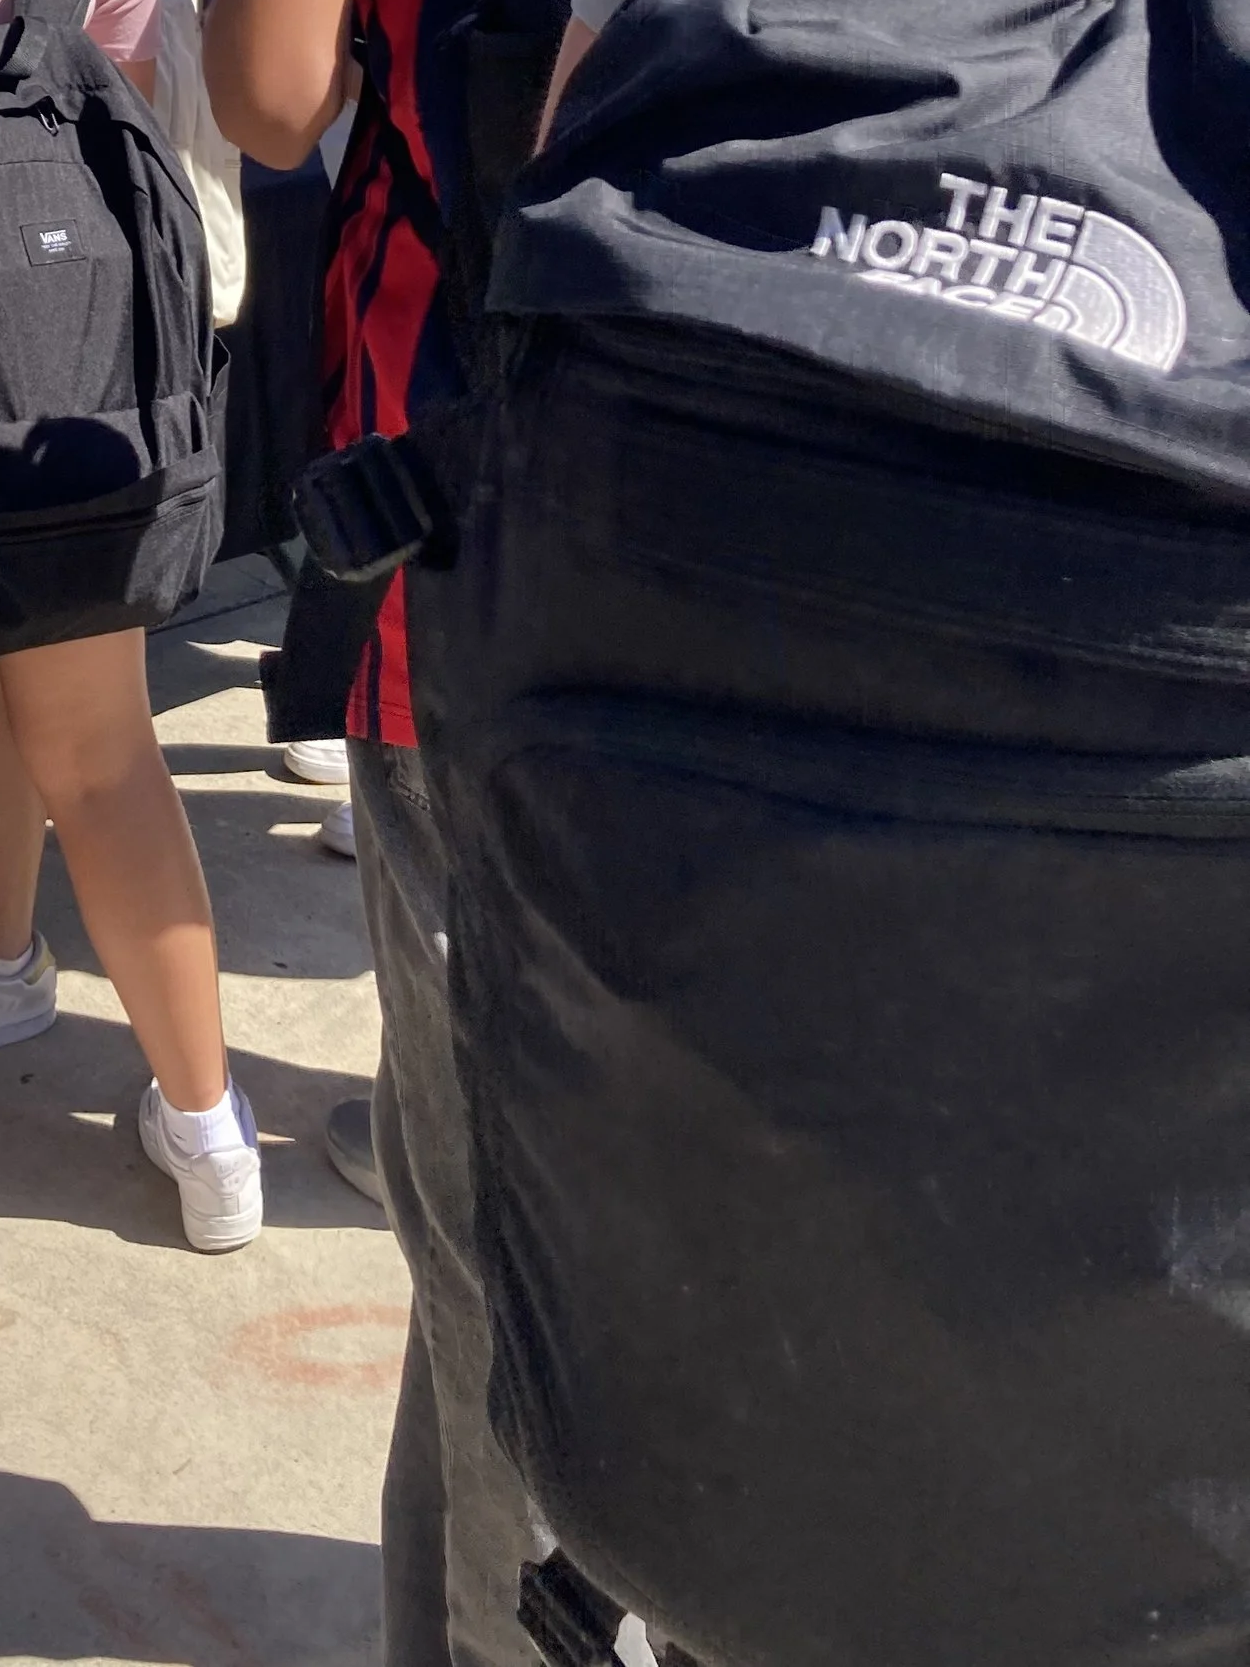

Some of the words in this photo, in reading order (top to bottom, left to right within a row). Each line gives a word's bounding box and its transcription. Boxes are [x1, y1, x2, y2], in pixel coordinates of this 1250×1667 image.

[39, 229, 68, 244] VANS
[810, 206, 1067, 300] NORTH
[939, 172, 1085, 258] THE
